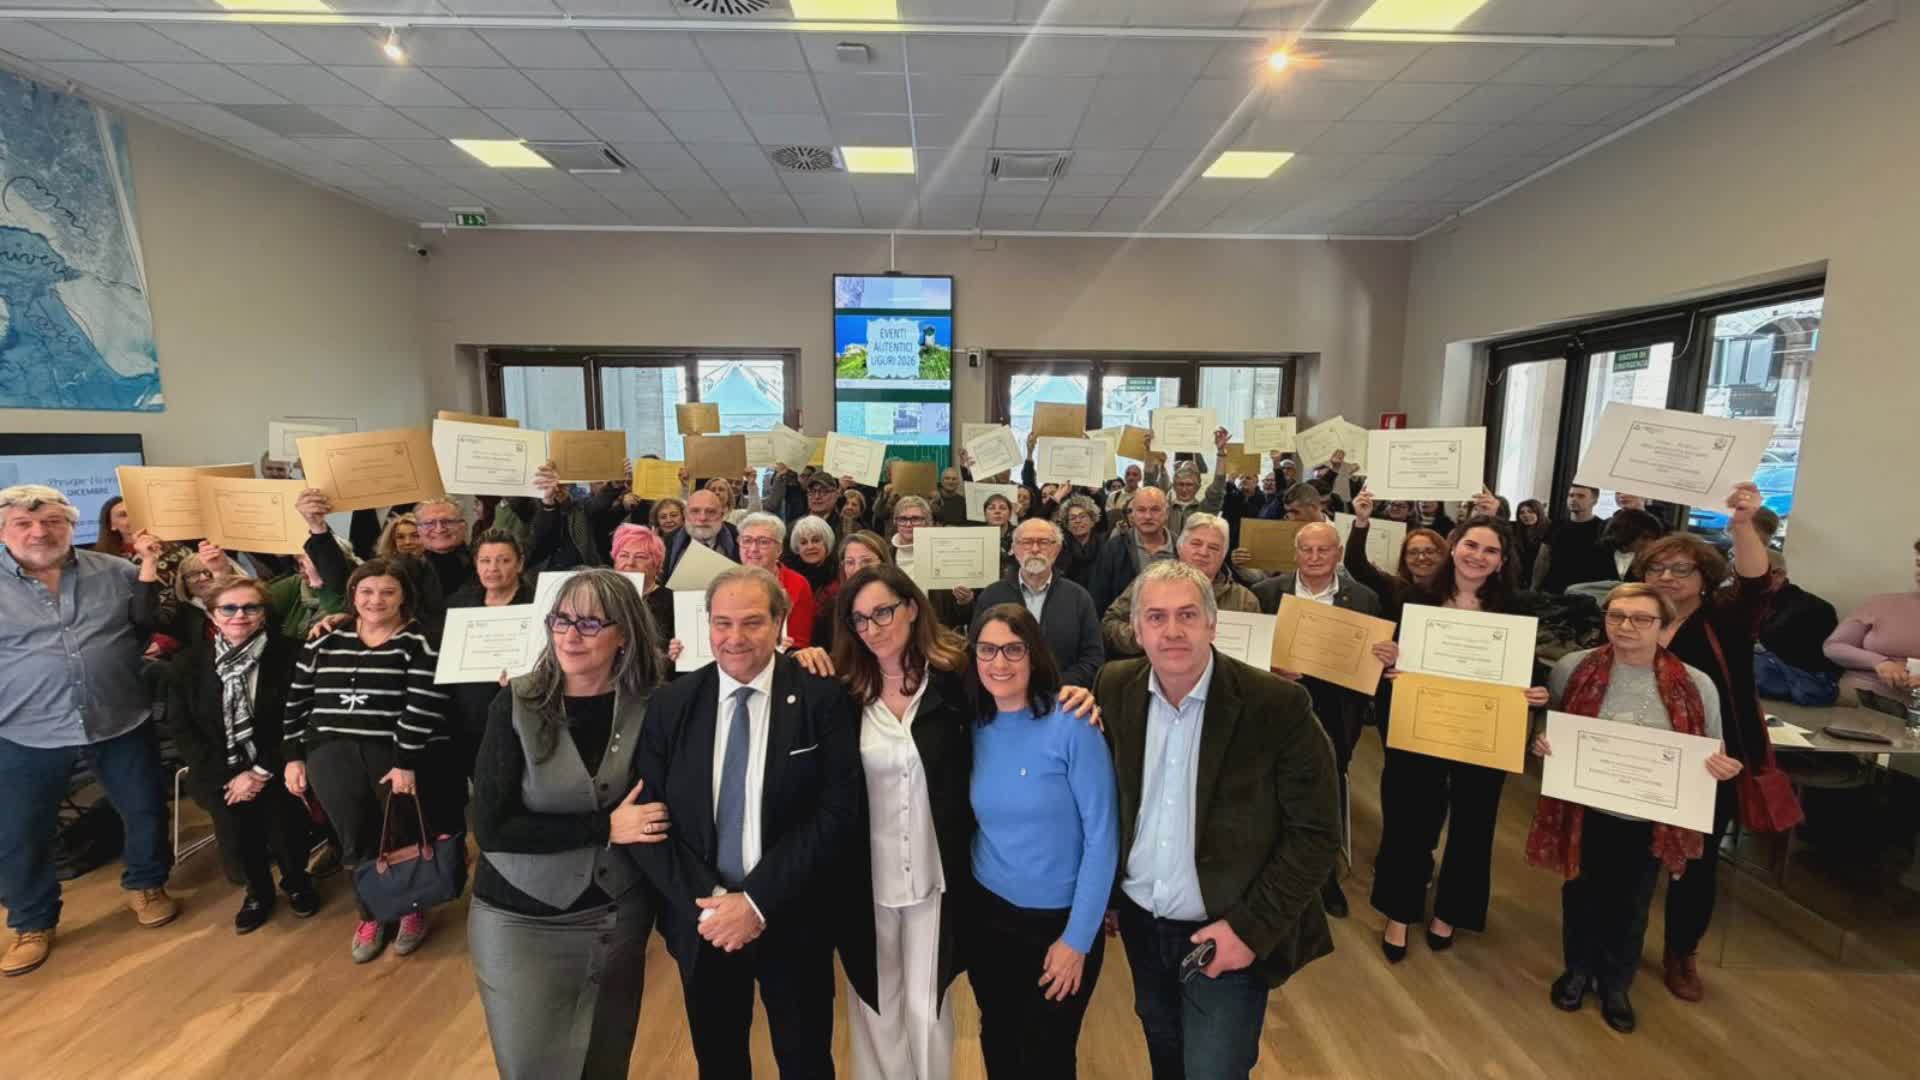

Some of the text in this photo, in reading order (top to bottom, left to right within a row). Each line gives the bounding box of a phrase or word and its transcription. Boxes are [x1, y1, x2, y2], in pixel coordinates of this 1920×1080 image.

[880, 327, 907, 338] EVENTI
[873, 341, 913, 353] AUTENTICI
[871, 354, 916, 366] LIGURI 2026
[67, 487, 109, 496] DICEMBRE
